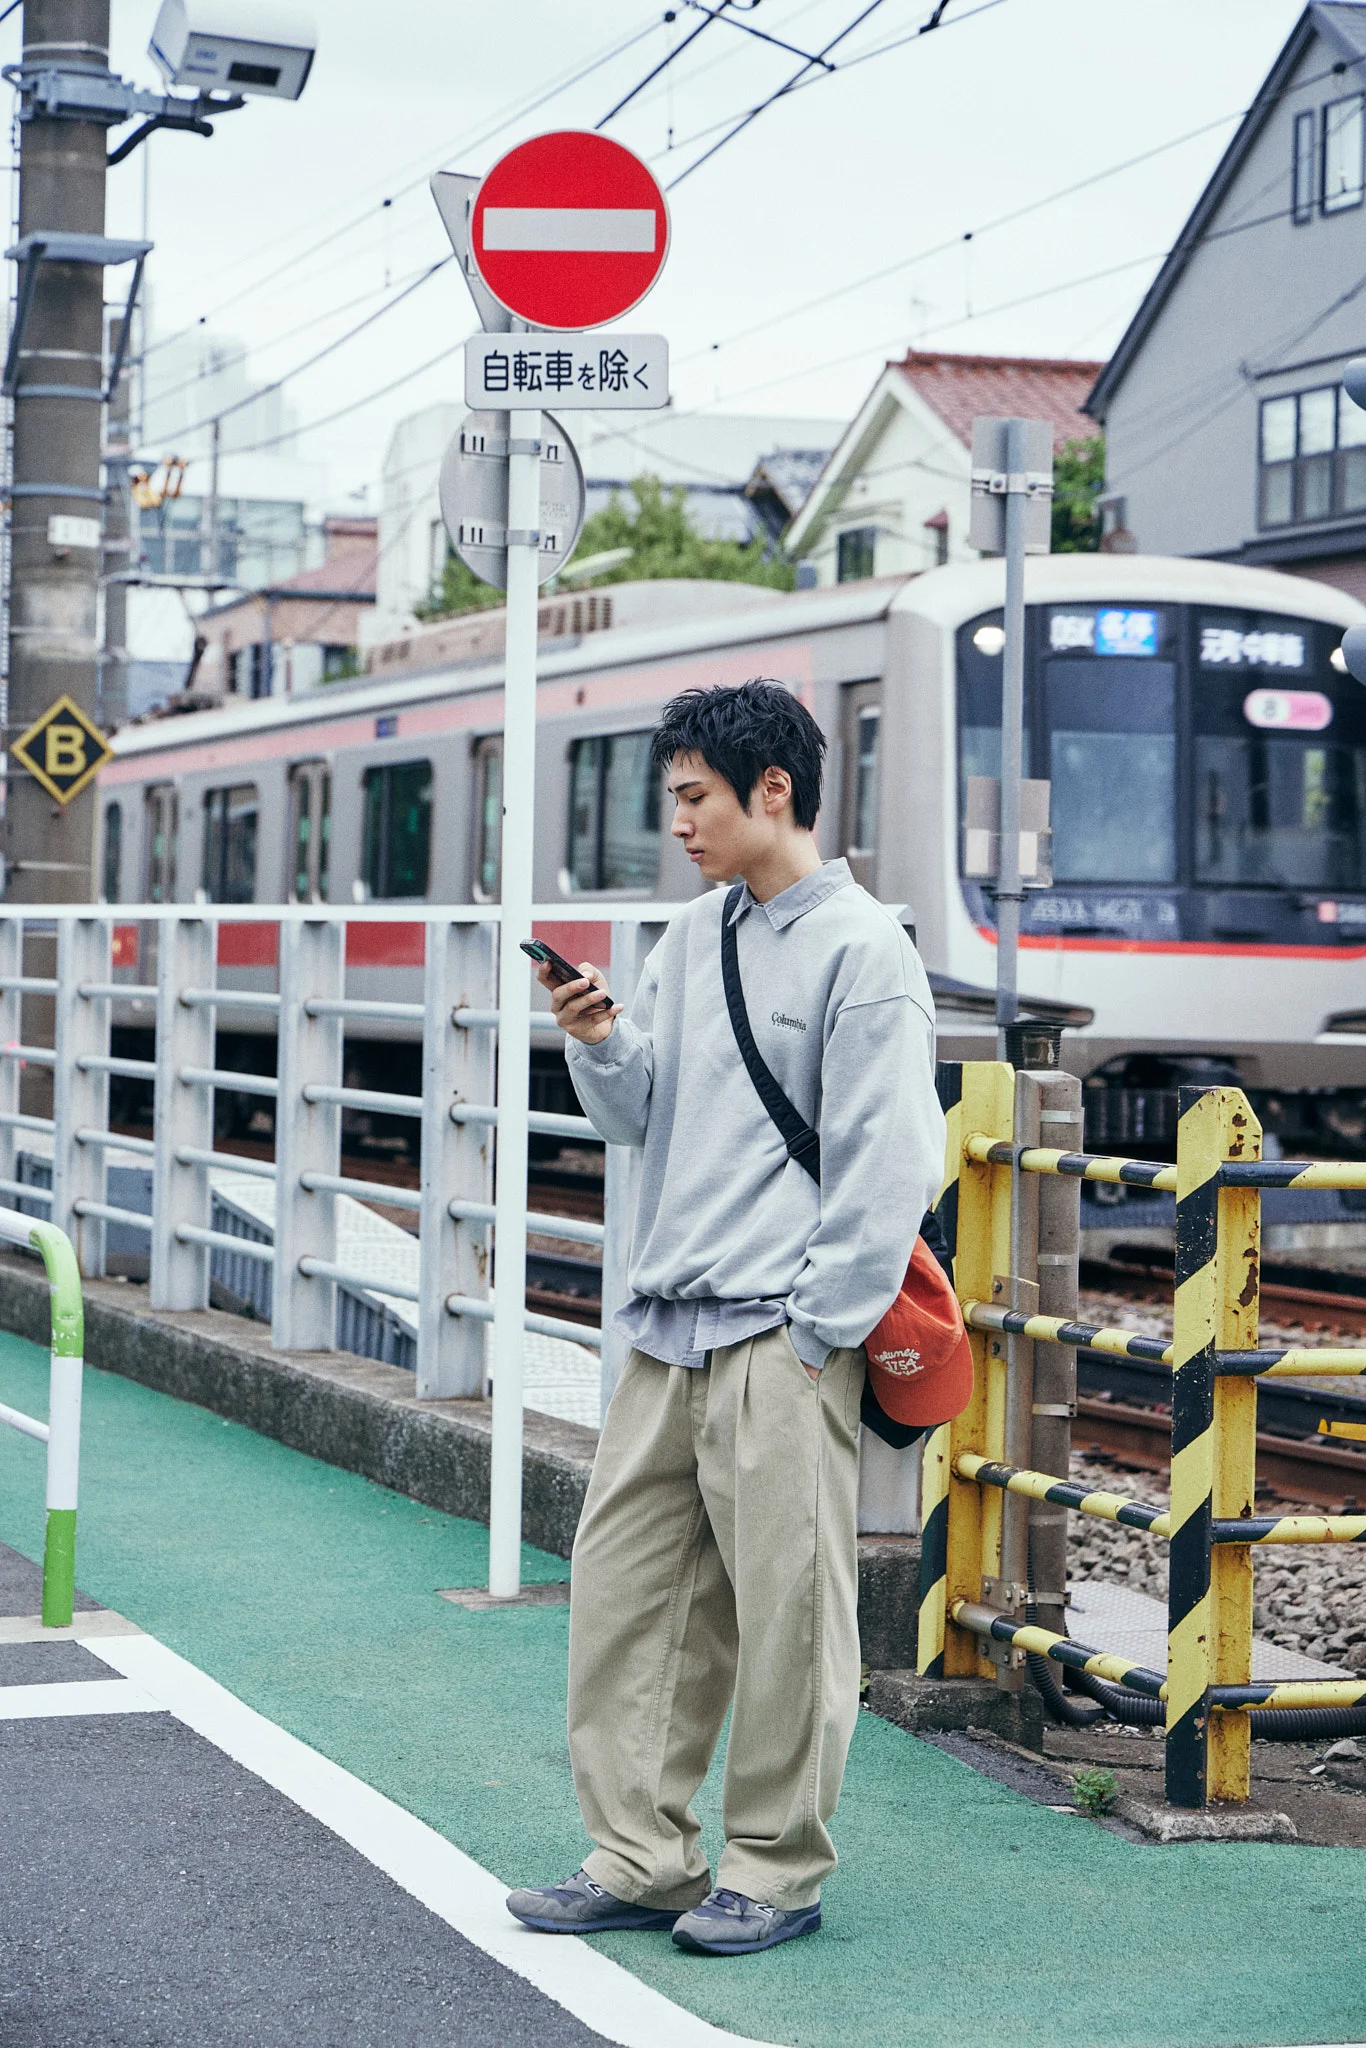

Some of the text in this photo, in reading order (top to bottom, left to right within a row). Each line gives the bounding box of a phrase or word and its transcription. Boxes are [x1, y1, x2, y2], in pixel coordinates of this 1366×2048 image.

[484, 349, 649, 392] 自転車を除く
[45, 723, 87, 775] B
[771, 1011, 807, 1031] Columbia
[885, 1358, 917, 1371] 1754
